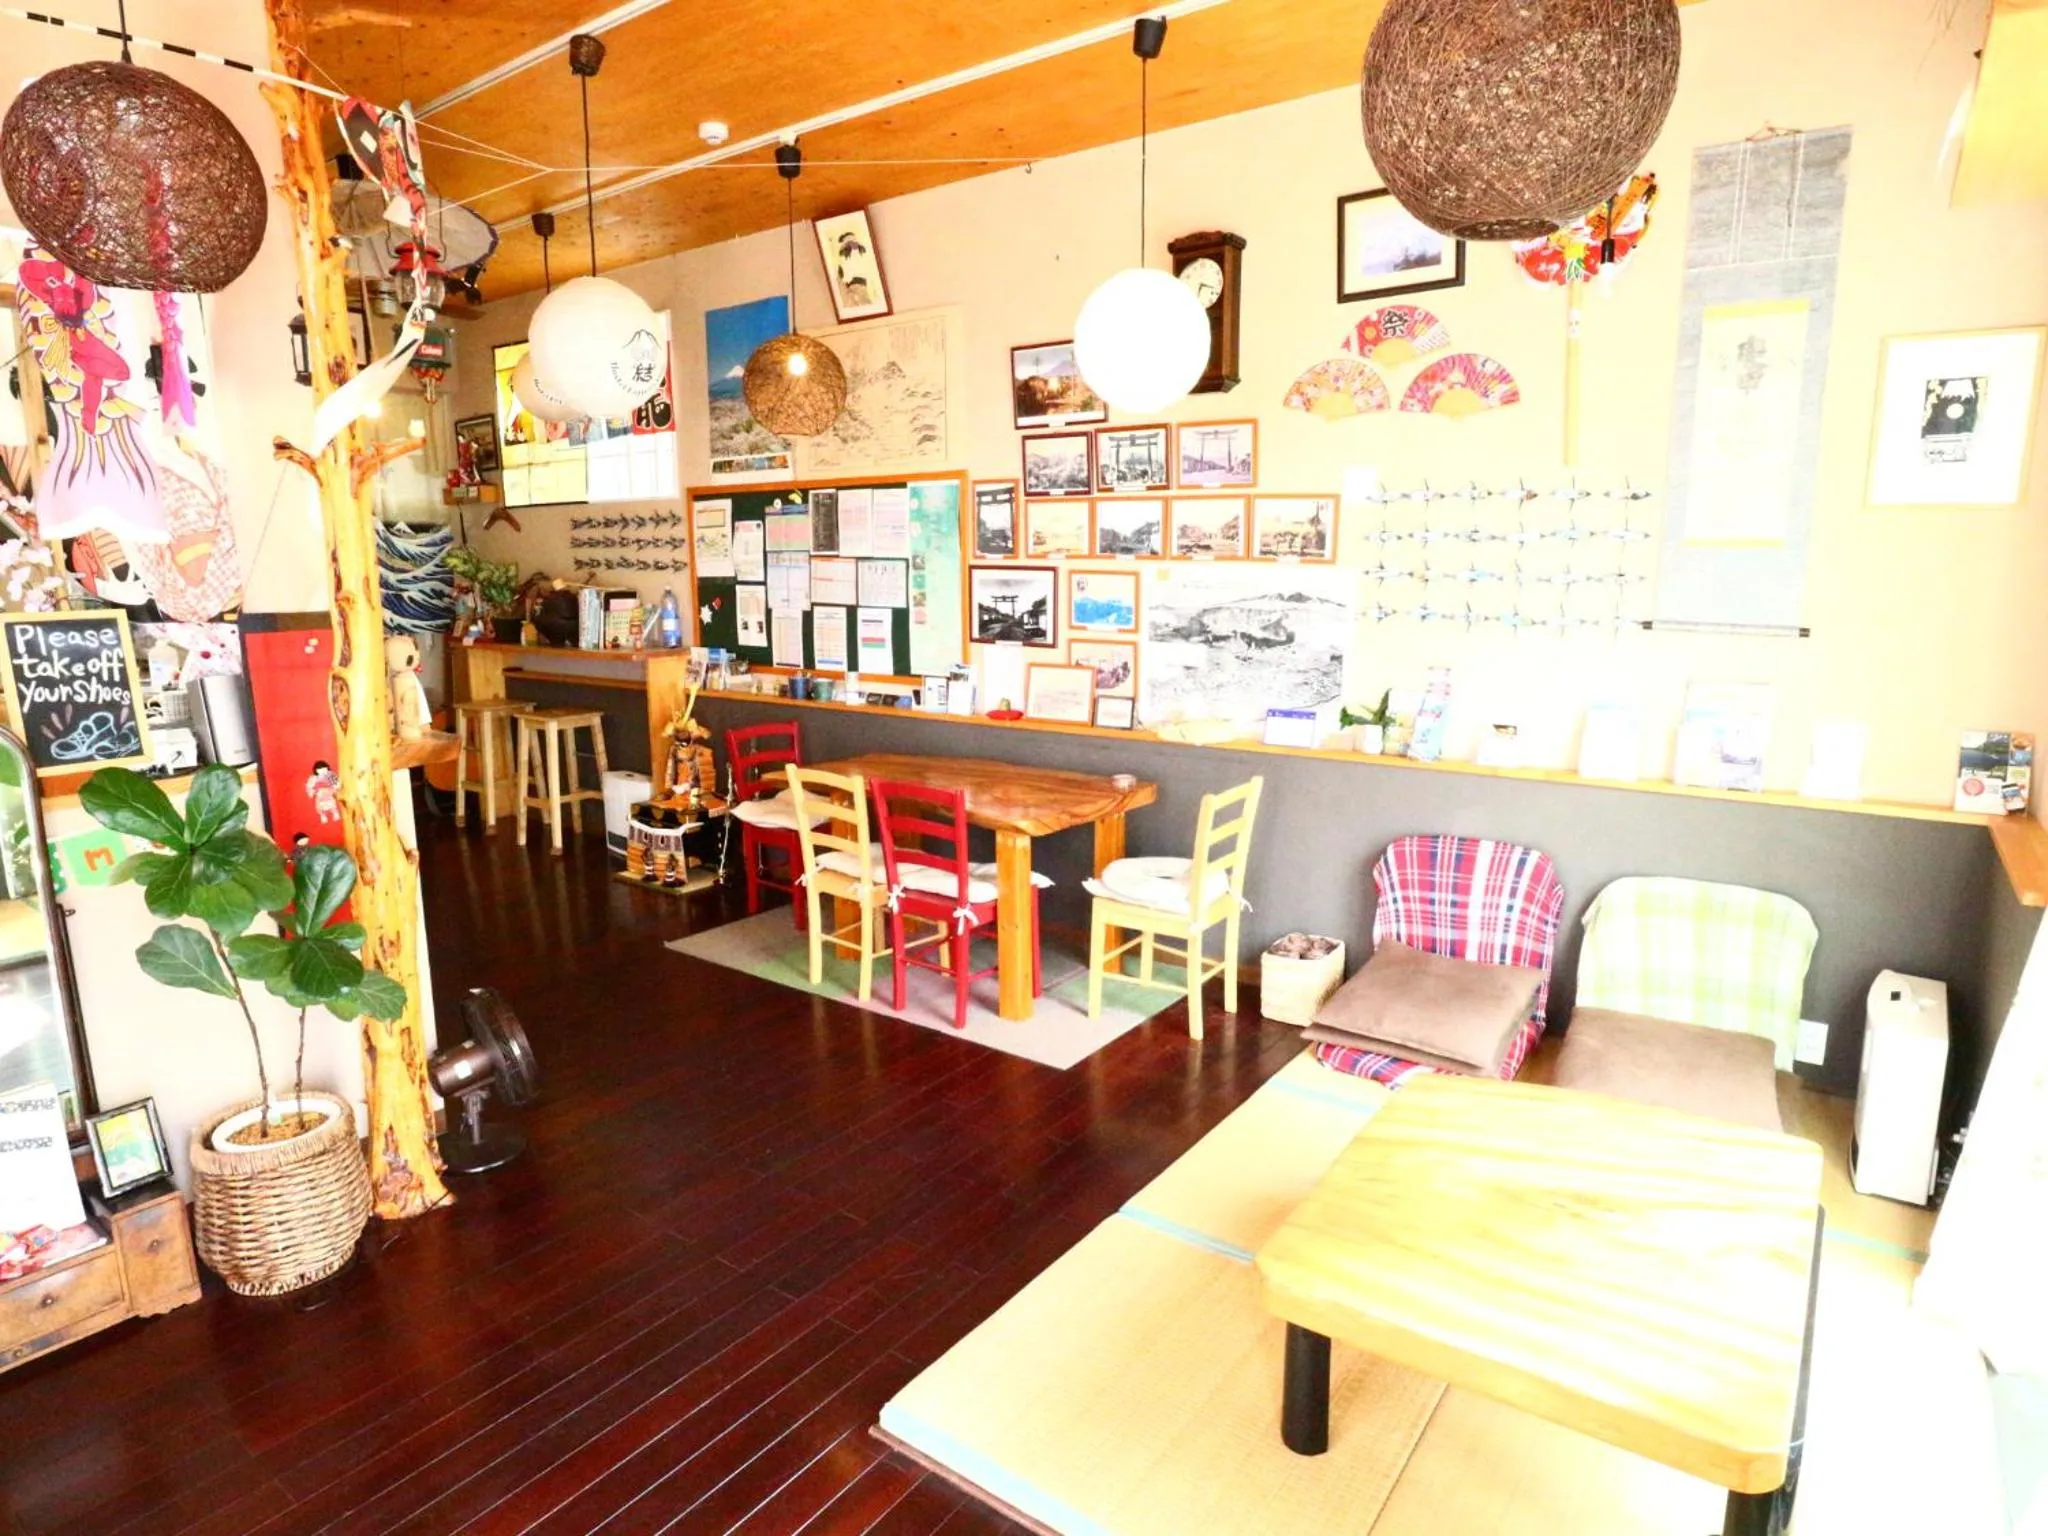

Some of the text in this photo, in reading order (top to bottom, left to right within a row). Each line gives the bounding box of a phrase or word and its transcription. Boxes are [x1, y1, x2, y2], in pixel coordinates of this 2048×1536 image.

[1382, 311, 1408, 336] 祭
[14, 625, 118, 656] Please
[13, 648, 125, 682] take off
